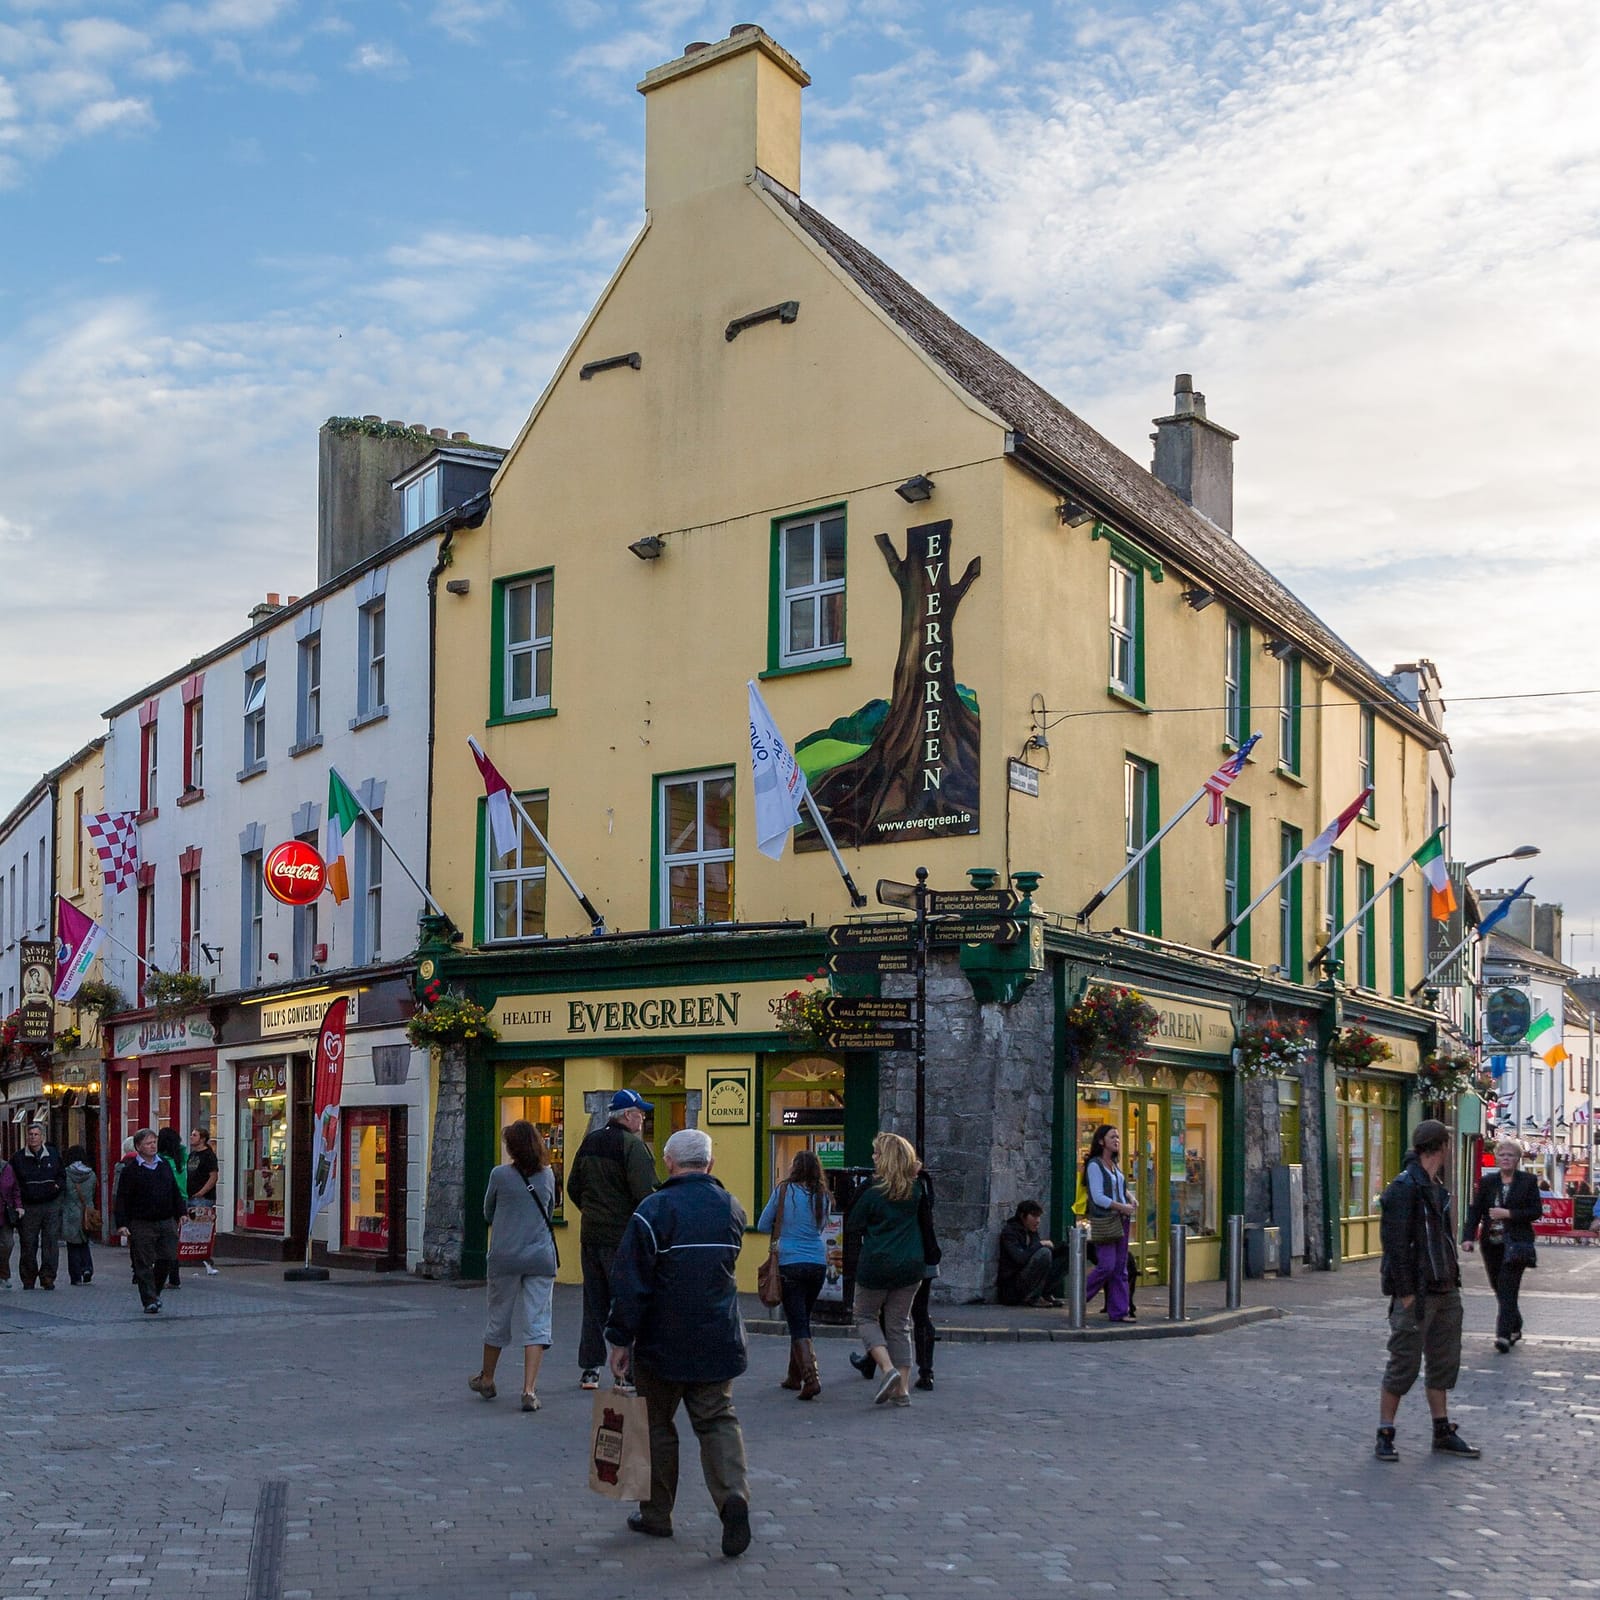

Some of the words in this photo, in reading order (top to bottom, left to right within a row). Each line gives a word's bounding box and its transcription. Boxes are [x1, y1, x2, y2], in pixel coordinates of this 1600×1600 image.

[923, 534, 945, 792] EVERGREEN
[750, 721, 769, 761] OLVO
[877, 810, 971, 833] www.evergreen.ie
[859, 936, 888, 944] SPANISH
[877, 962, 908, 970] MUSEUM
[26, 1010, 48, 1018] IRISH
[263, 1009, 286, 1029] TULLY'S
[287, 1002, 331, 1025] CONVENIENC
[502, 1010, 552, 1026] HEALTH
[566, 991, 742, 1033] EVERGREEN
[26, 1029, 47, 1037] SHOP
[1208, 1023, 1228, 1038] STORE
[711, 1085, 745, 1105] EVERGREEN
[711, 1108, 745, 1116] CORNER
